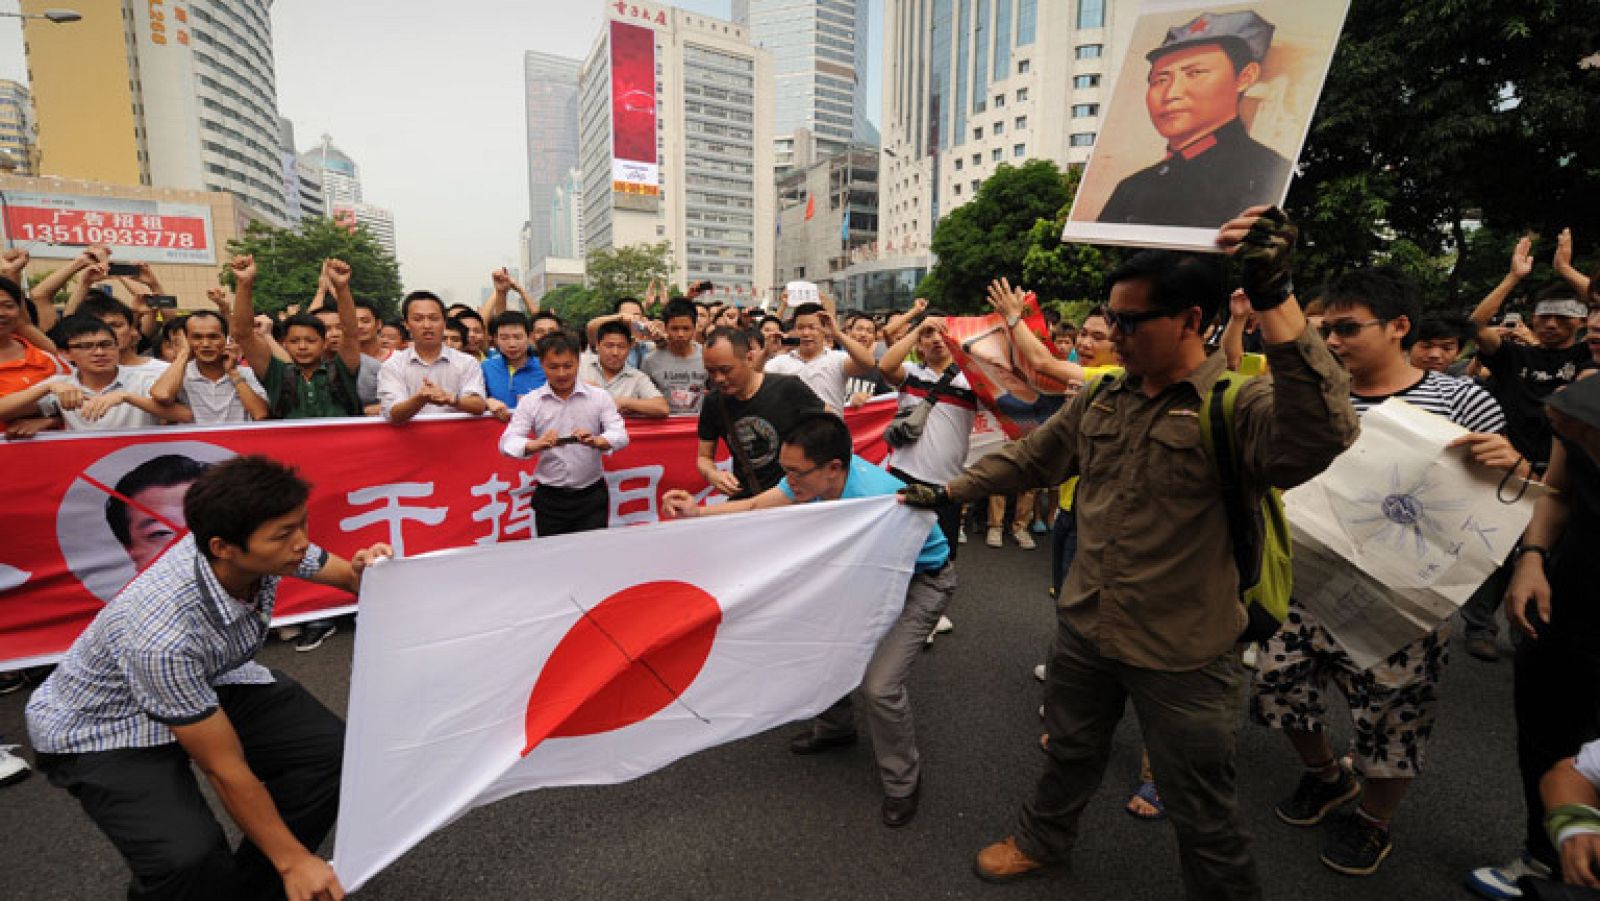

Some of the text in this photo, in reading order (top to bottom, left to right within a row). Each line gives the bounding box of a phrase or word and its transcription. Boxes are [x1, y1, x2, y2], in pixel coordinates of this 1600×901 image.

[52, 209, 164, 231] 广告招租
[22, 223, 195, 248] 13510933778
